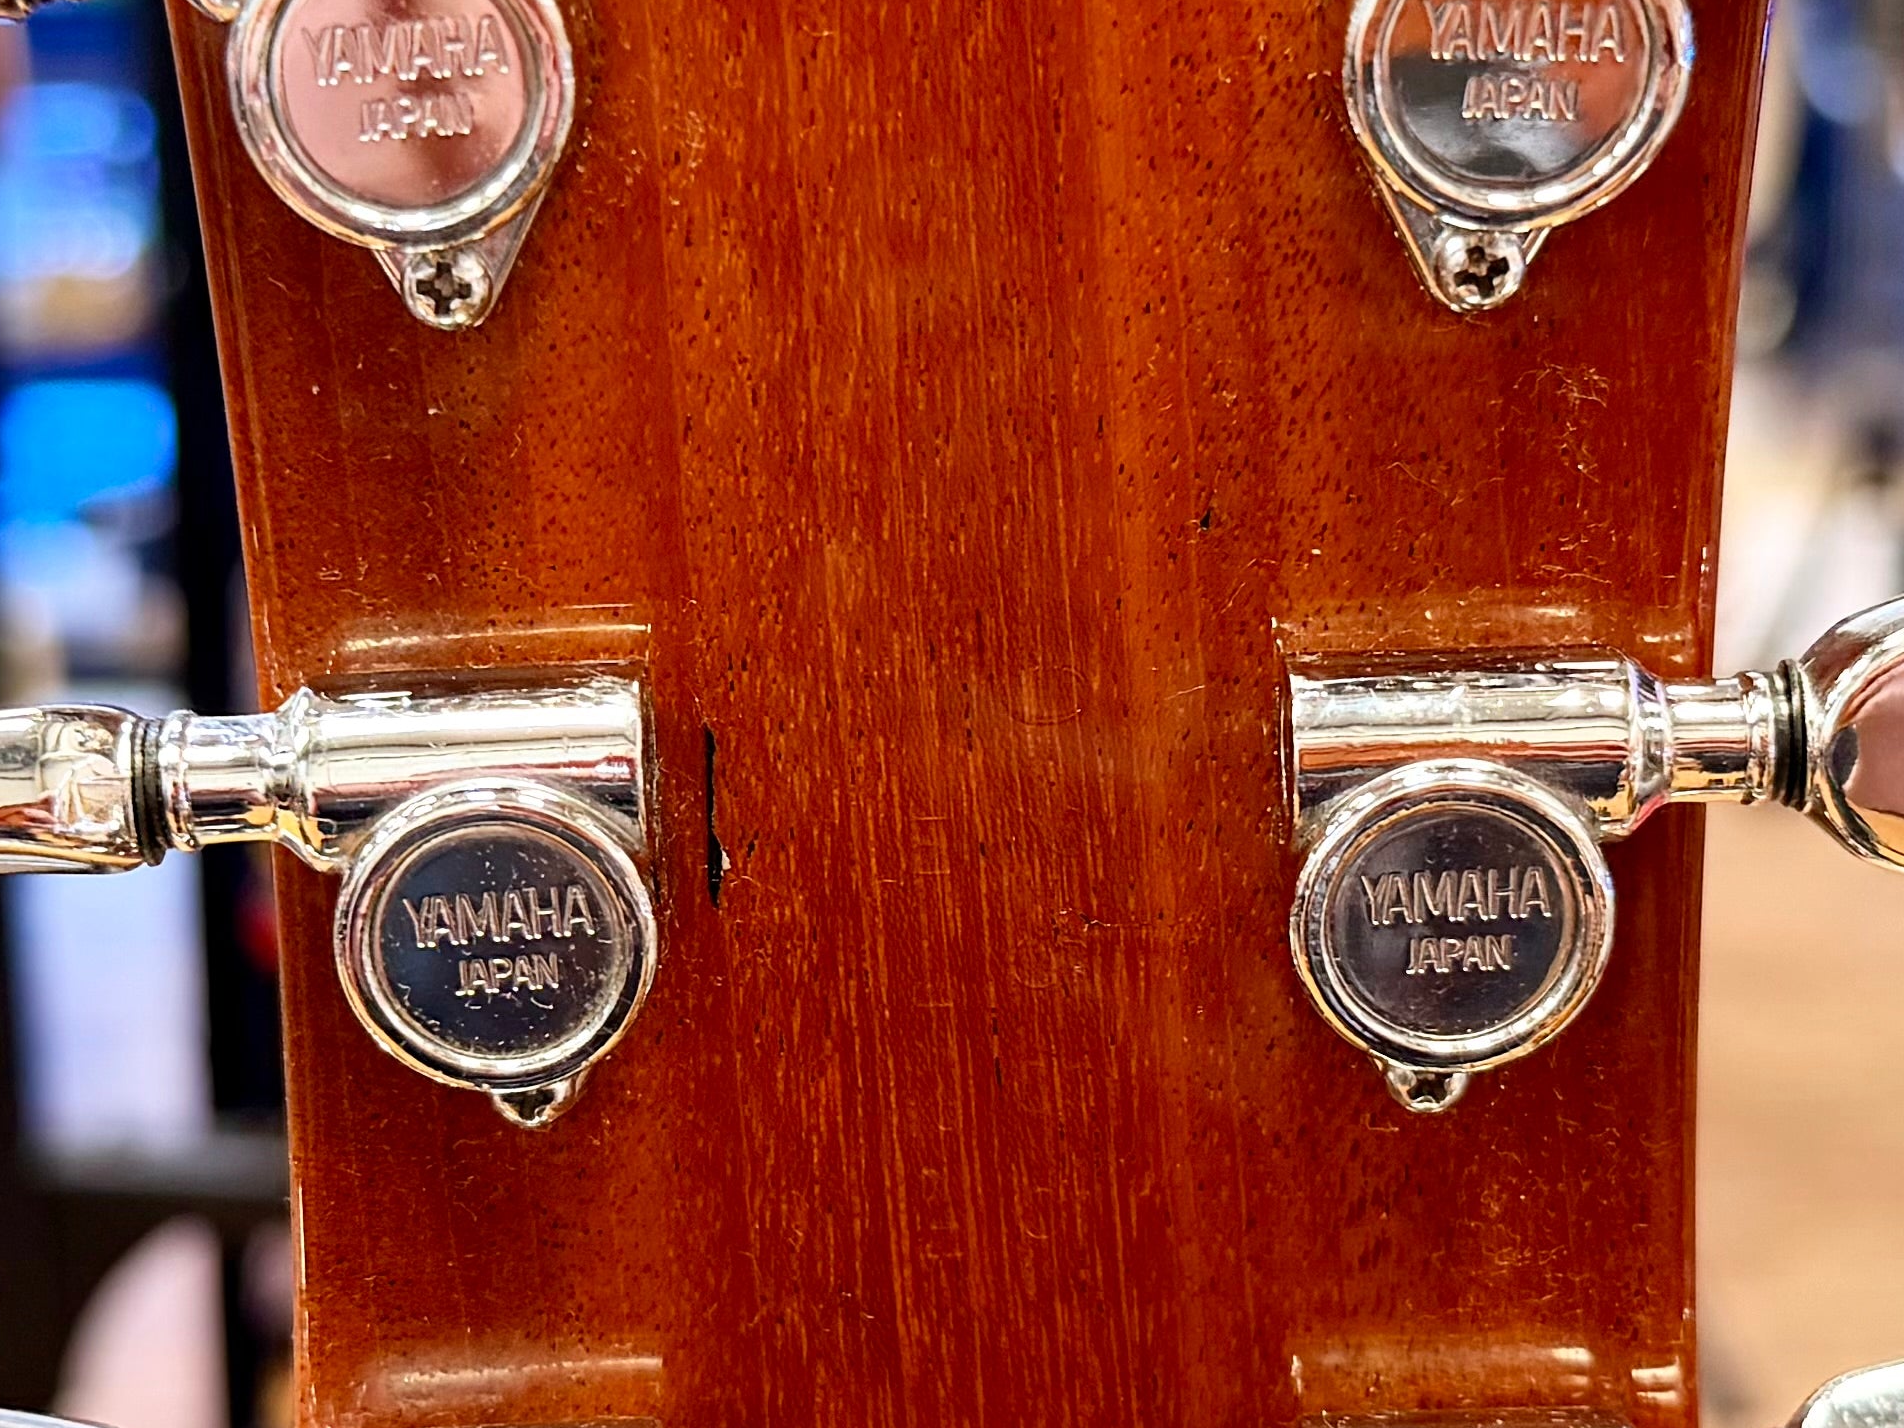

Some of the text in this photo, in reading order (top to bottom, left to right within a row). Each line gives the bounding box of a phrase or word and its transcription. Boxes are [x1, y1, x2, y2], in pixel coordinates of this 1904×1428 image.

[301, 13, 509, 86] YAMAHA
[1461, 74, 1578, 121] JAPAN
[402, 884, 596, 948] YAMAHA
[1360, 866, 1552, 925] YAMAHA
[455, 951, 559, 996] JAPAN
[1405, 934, 1513, 975] JAPAN
